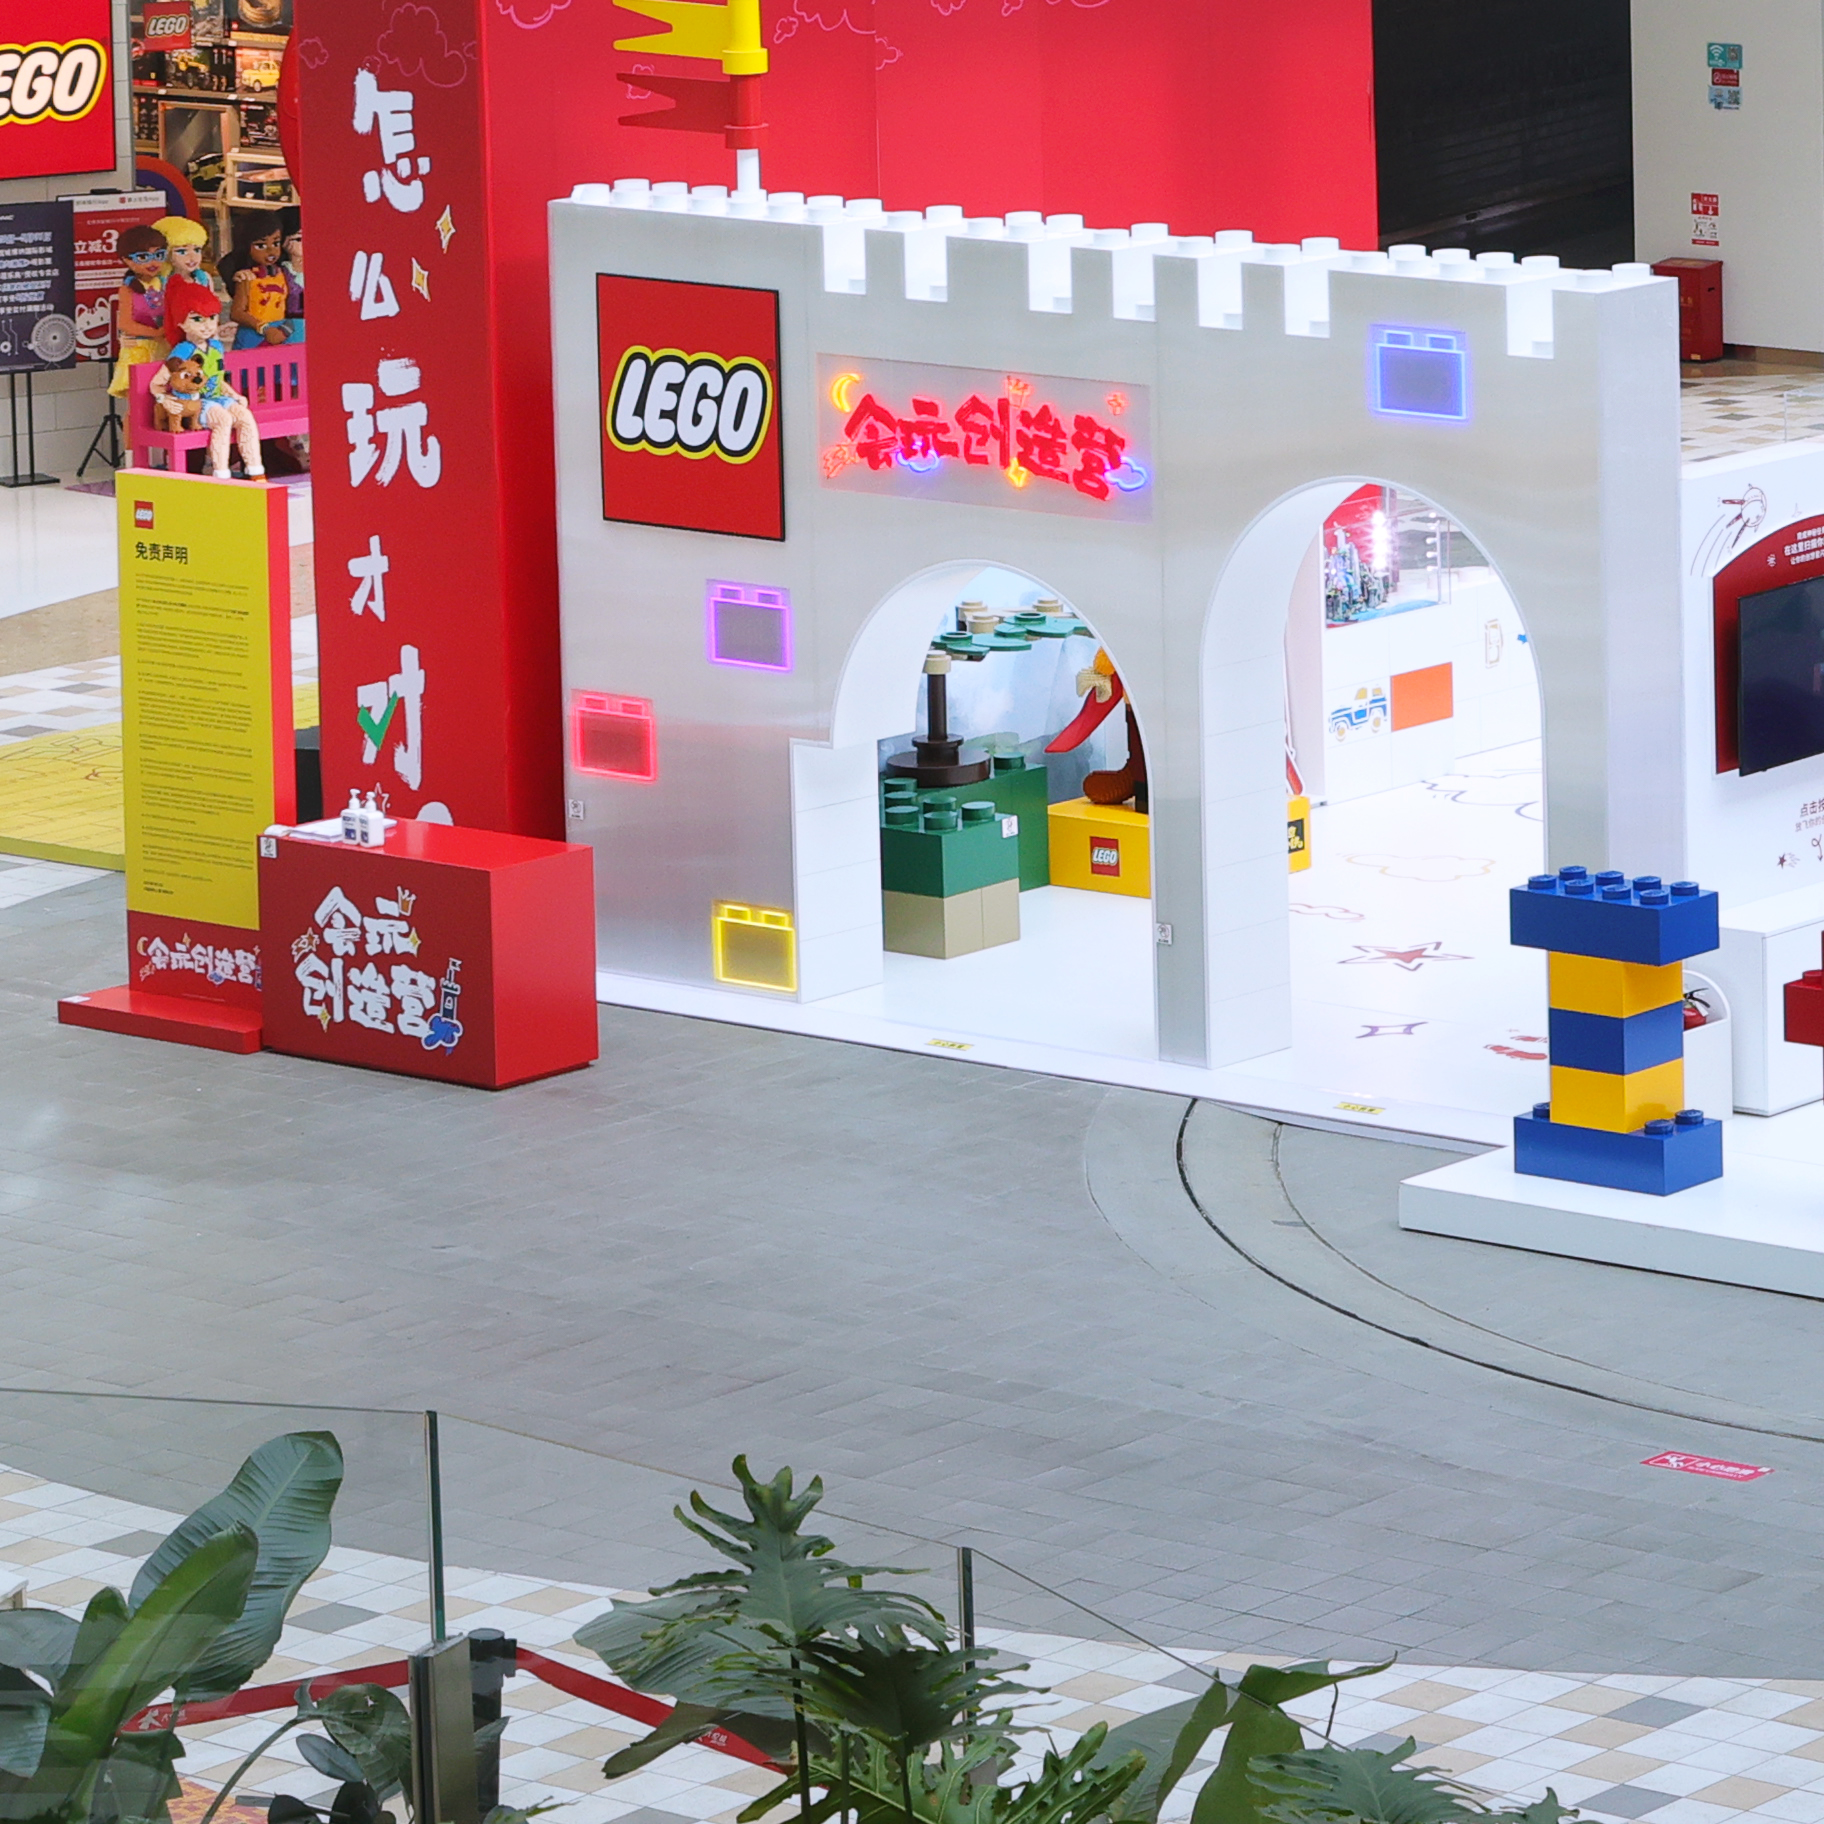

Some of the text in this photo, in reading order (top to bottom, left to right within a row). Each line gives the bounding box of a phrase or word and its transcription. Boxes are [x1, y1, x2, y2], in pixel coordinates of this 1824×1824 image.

[146, 14, 189, 37] LEGO
[611, 353, 766, 457] LEGO
[340, 68, 455, 825] 怎么玩才对
[844, 392, 1127, 501] 会玩创造营
[135, 541, 189, 565] 免责声明
[1091, 848, 1119, 865] LEGO
[147, 936, 256, 985] 会玩创造营
